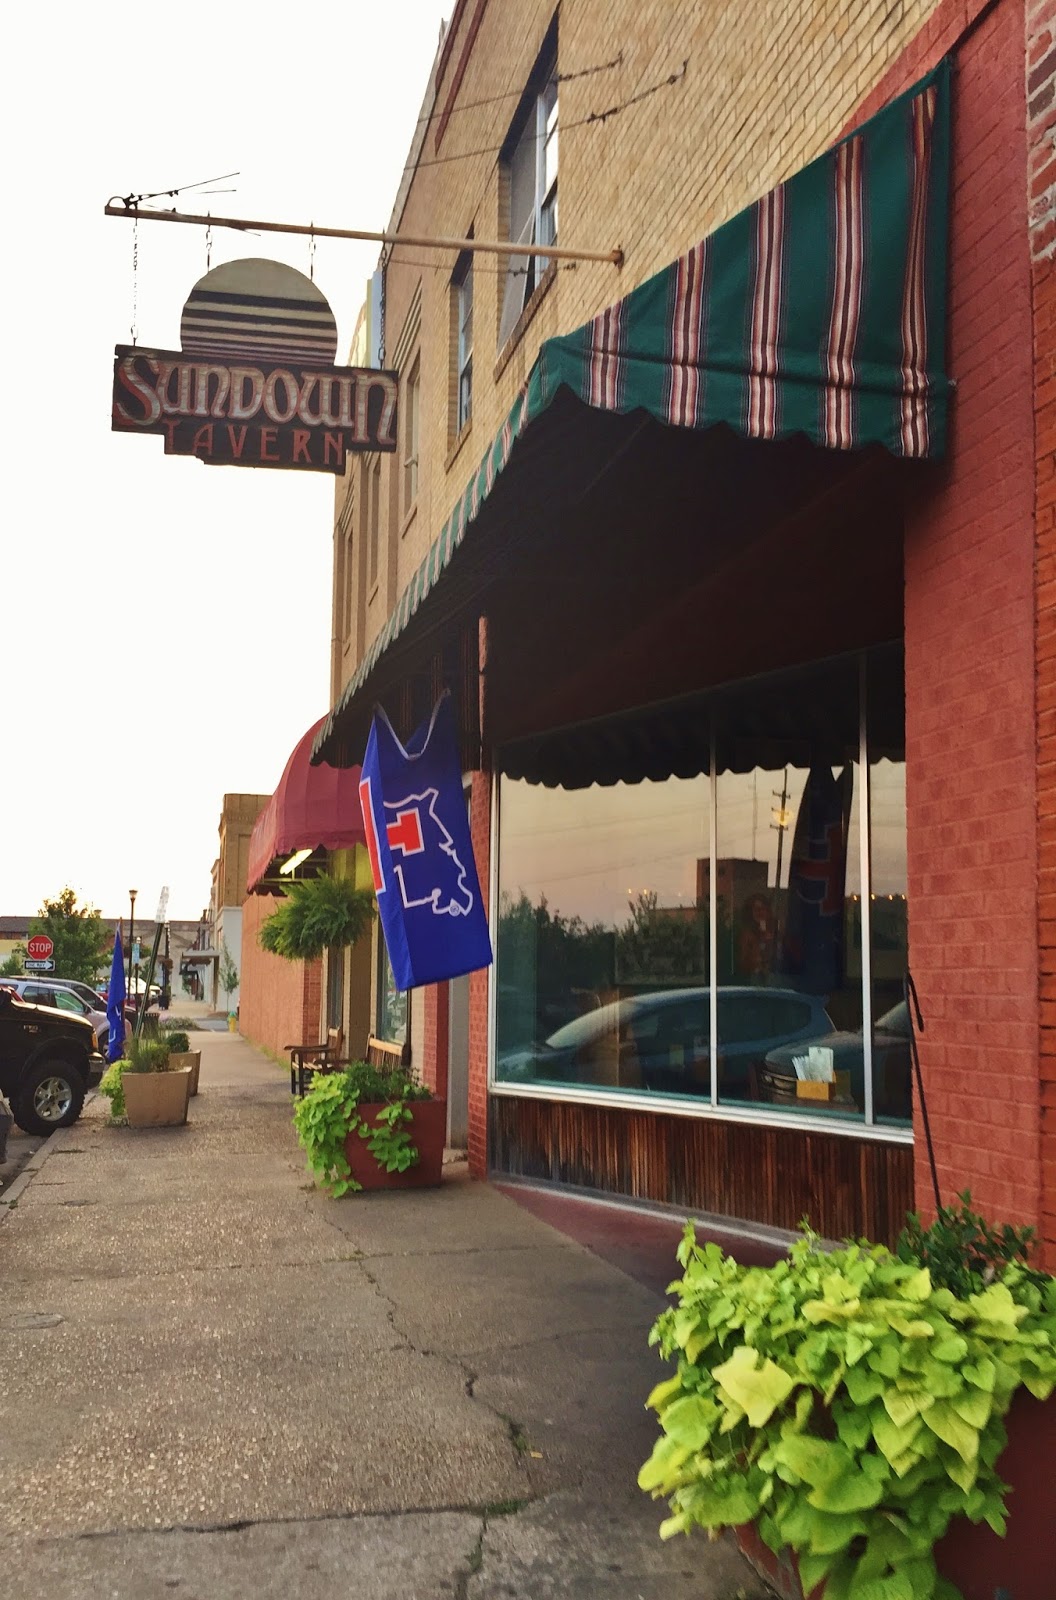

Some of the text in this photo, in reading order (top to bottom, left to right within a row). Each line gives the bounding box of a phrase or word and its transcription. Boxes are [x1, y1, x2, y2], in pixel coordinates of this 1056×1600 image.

[116, 353, 399, 444] SUNDOWN
[162, 418, 343, 465] TAVERN
[29, 942, 52, 953] STOP
